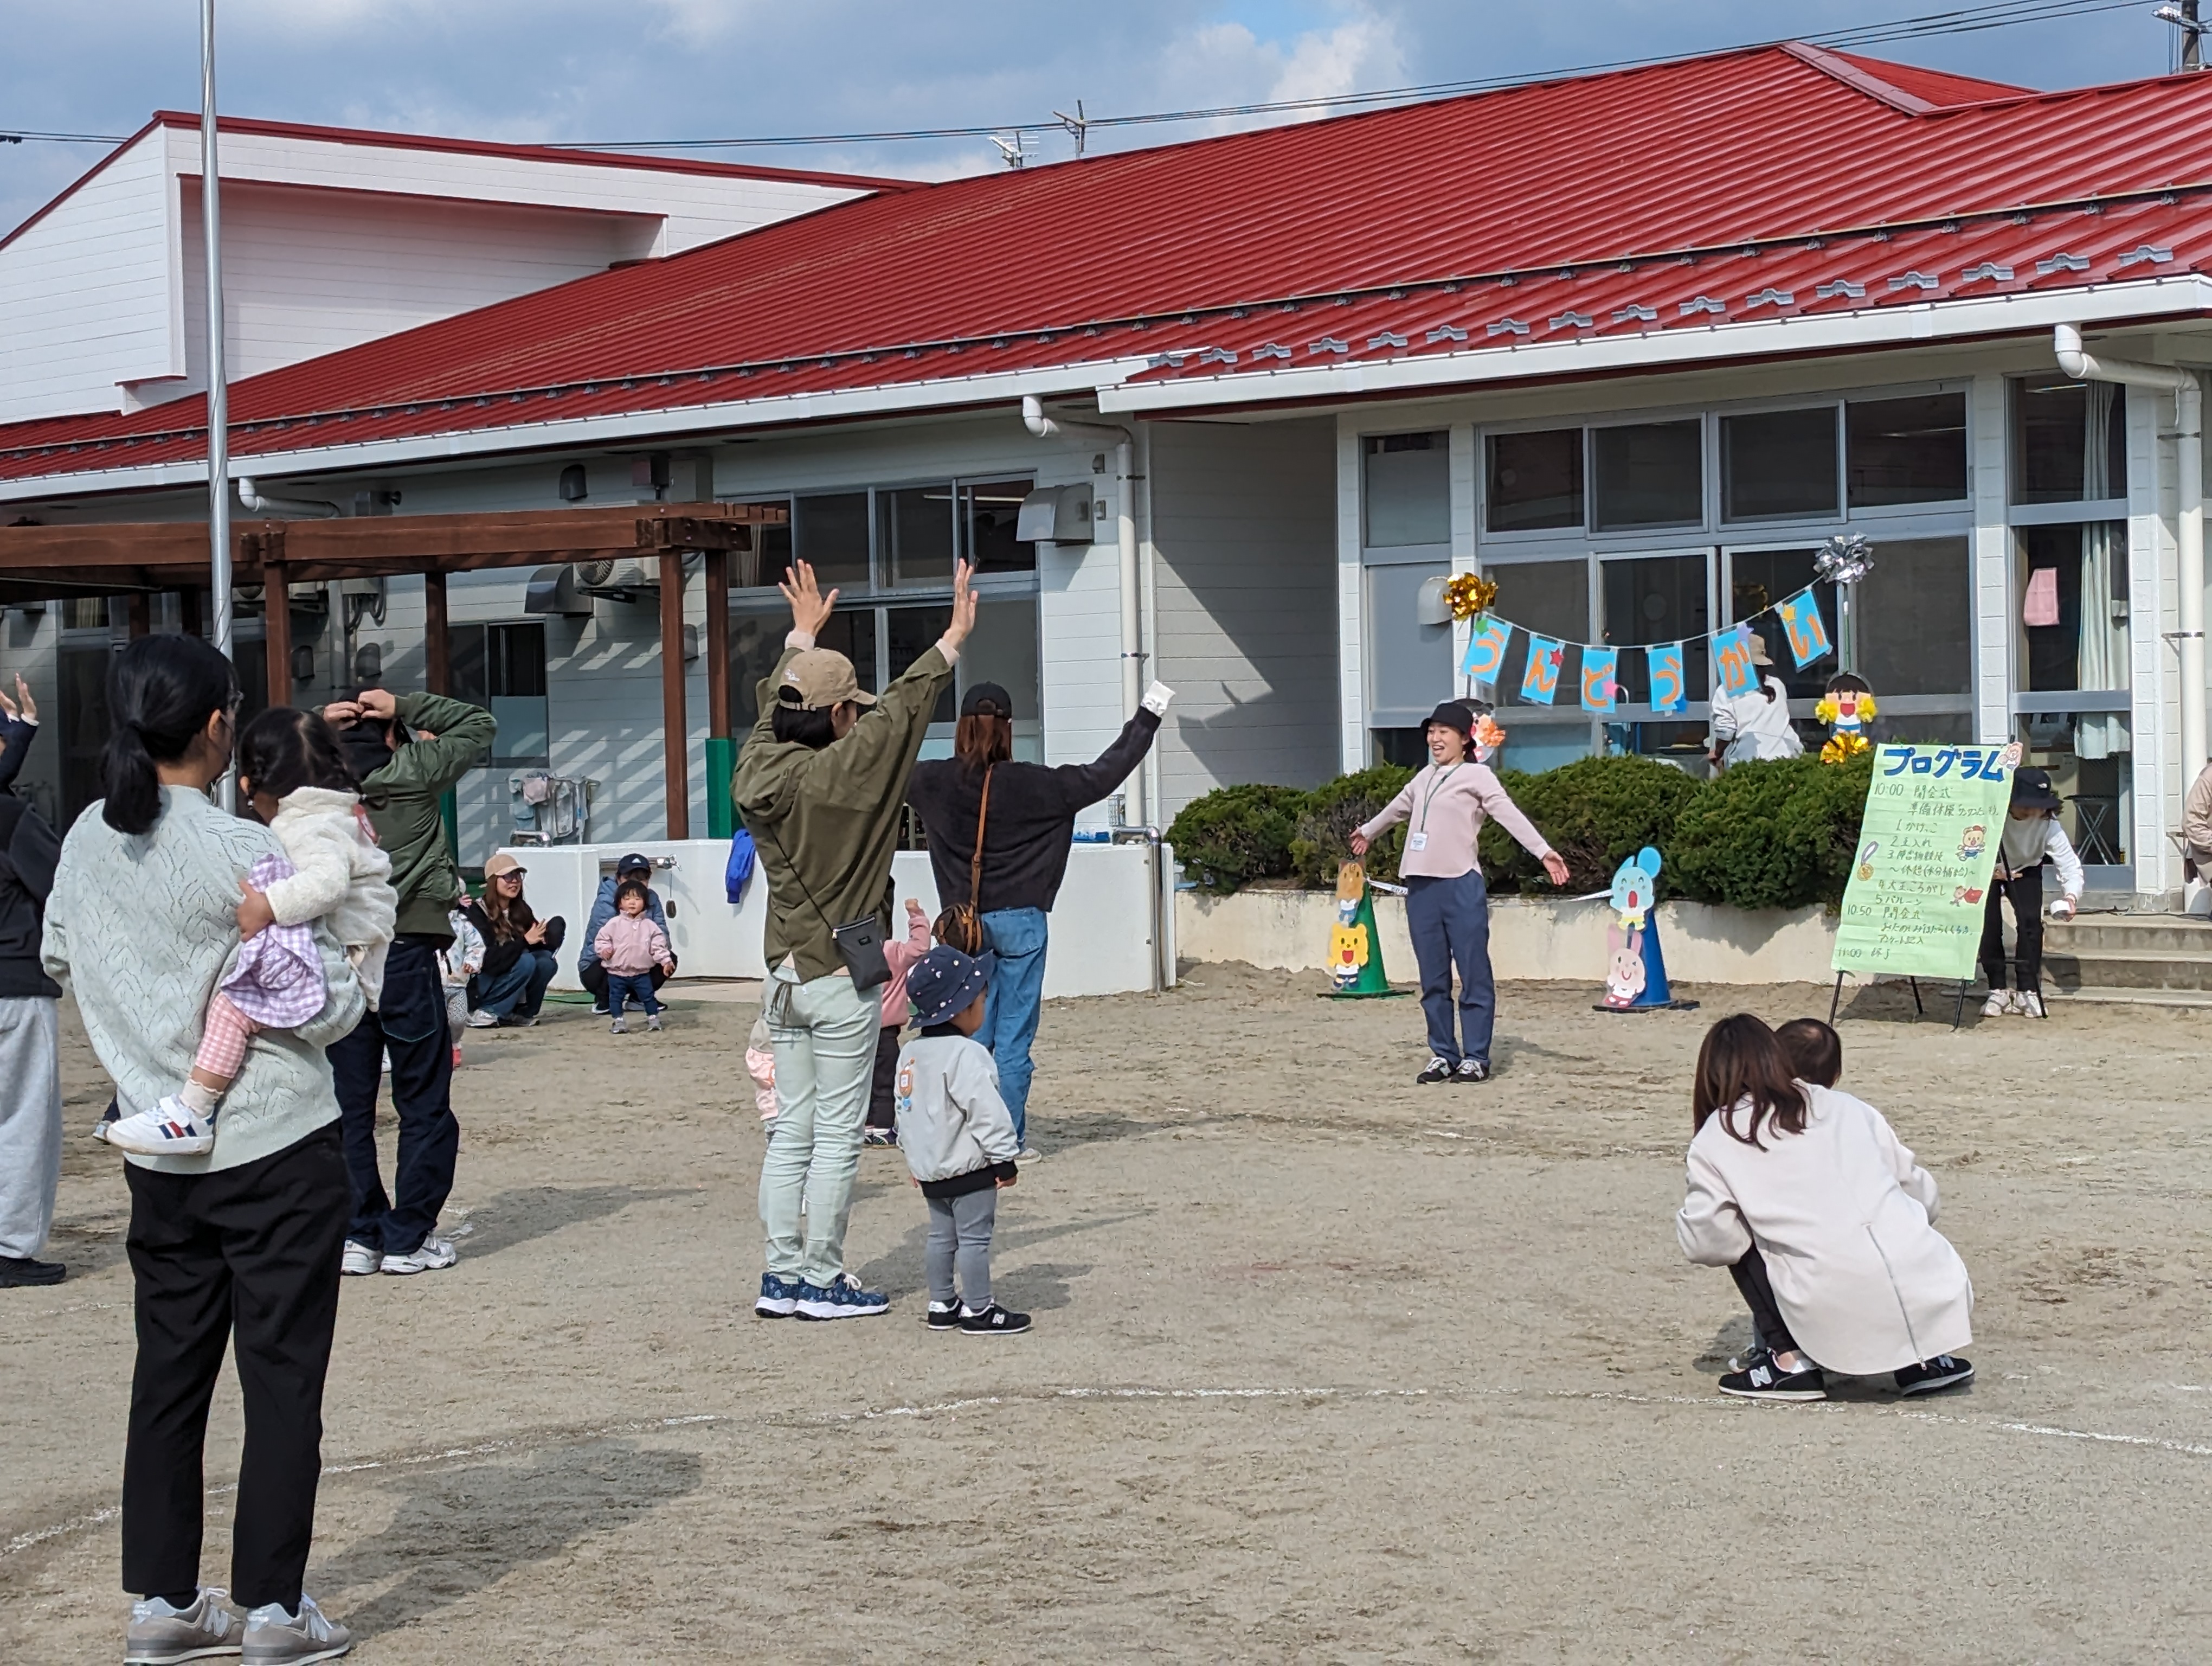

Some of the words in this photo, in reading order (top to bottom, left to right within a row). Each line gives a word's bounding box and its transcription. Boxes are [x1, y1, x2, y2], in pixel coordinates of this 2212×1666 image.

[1470, 614, 1824, 707] うんどうかい
[1883, 747, 2004, 783] プログラム
[1874, 783, 1904, 796] 10:00
[1913, 785, 1953, 800] 開会式
[1749, 1365, 1773, 1388] N
[203, 1605, 229, 1638] N
